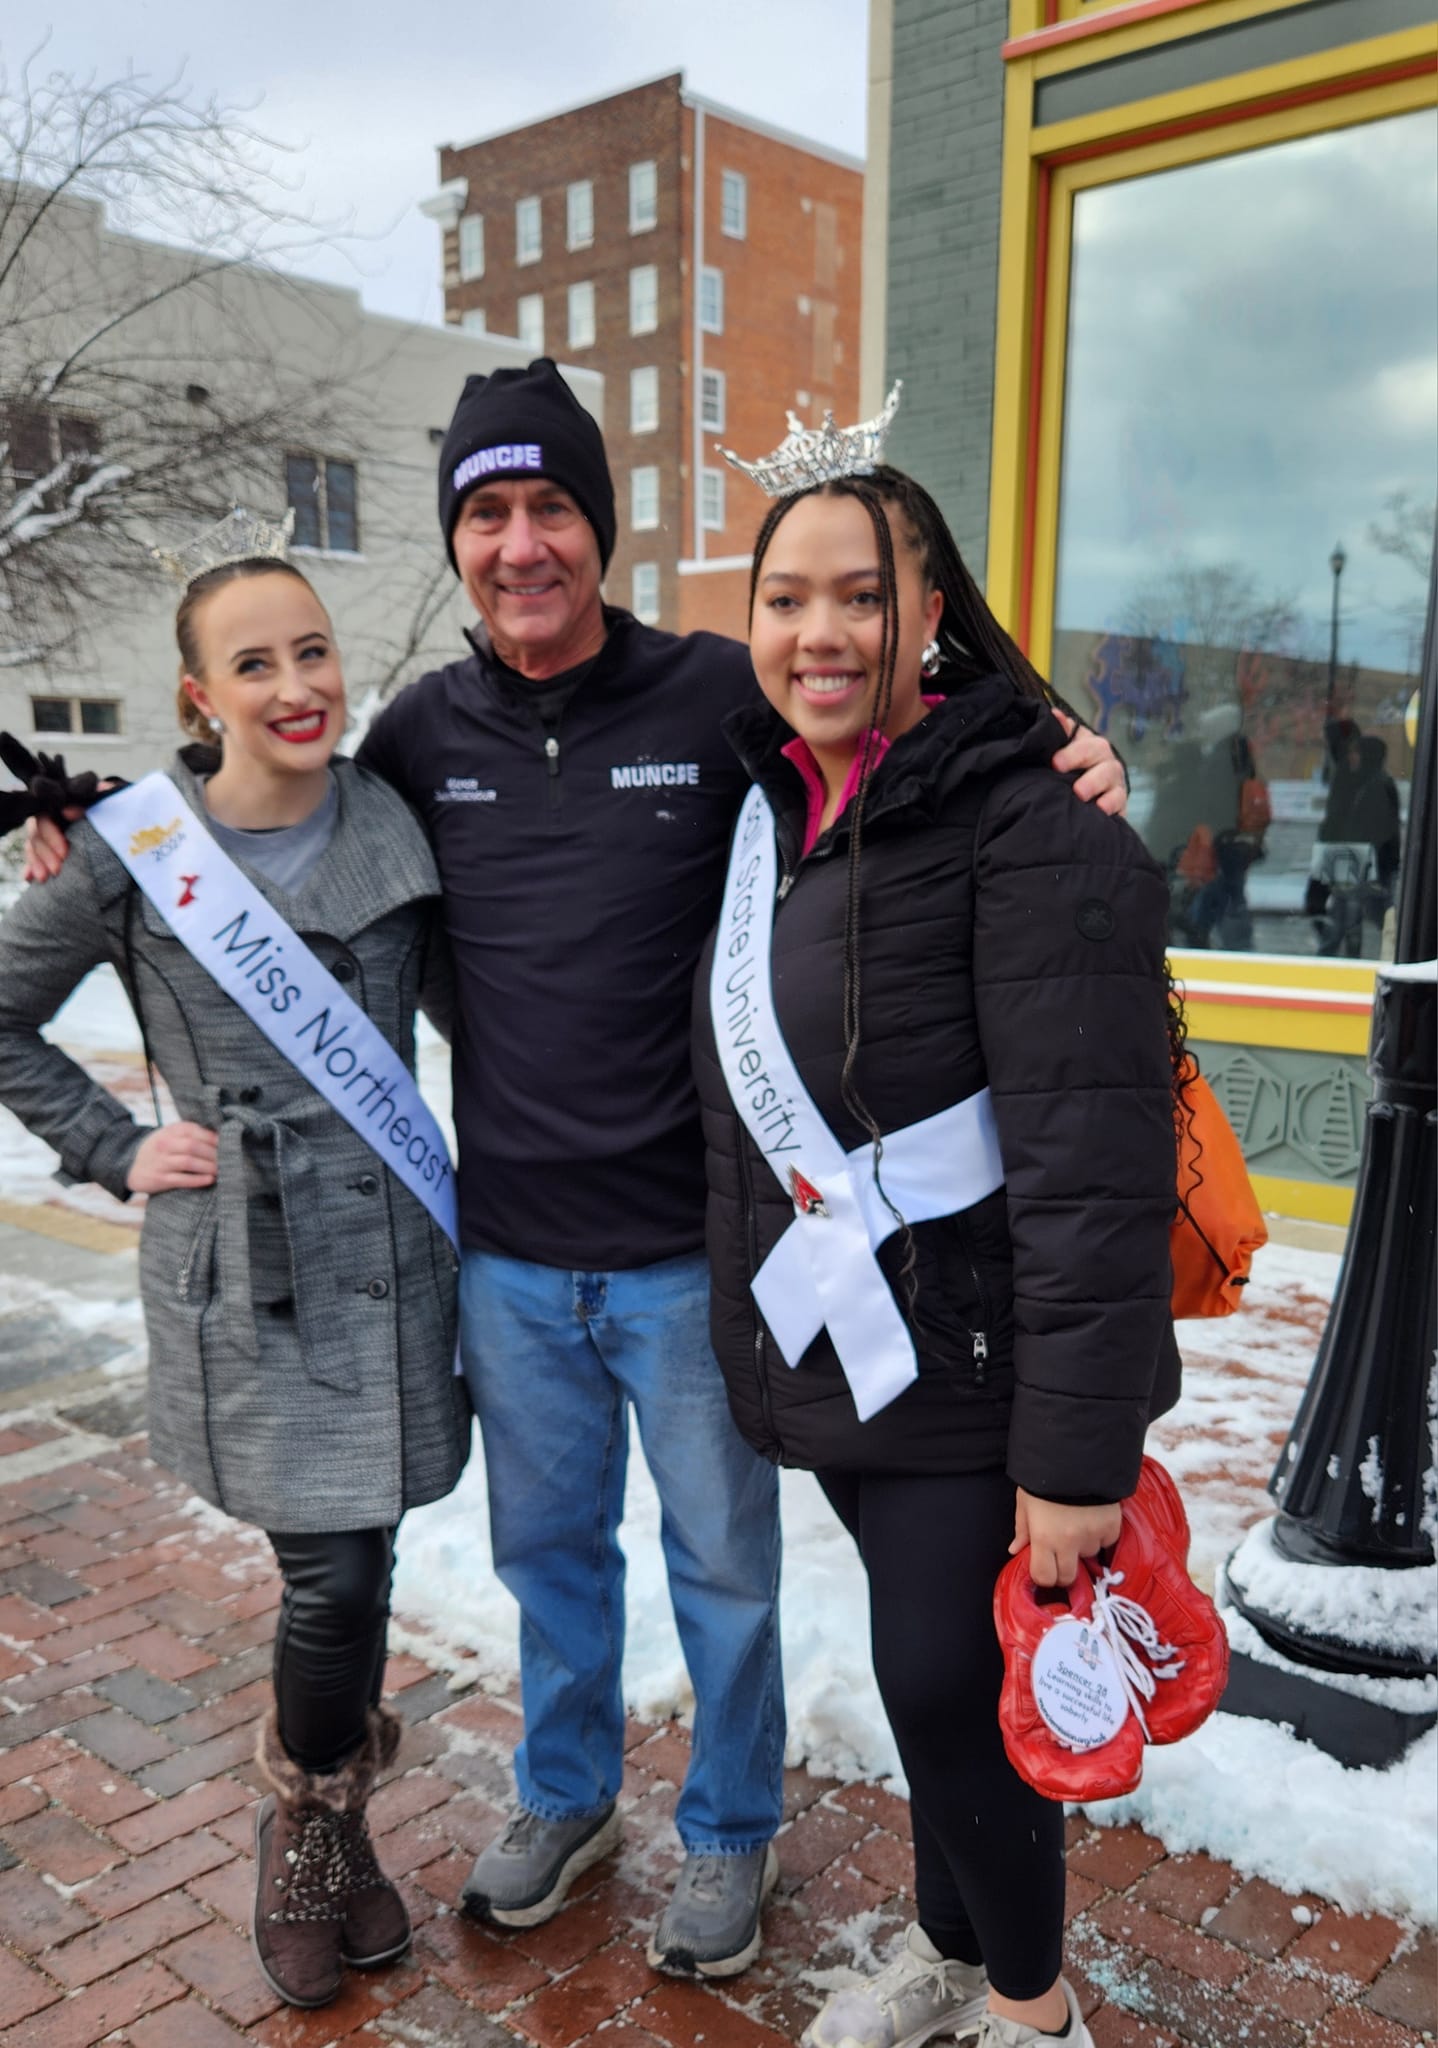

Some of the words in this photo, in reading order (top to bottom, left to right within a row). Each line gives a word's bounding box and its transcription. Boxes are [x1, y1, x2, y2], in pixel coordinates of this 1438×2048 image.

[453, 443, 542, 491] MUNCIE
[611, 763, 700, 790] MUNCIE
[728, 854, 761, 958] State
[212, 910, 302, 1014] Miss
[295, 1007, 451, 1193] Northeast
[725, 957, 802, 1155] University
[1039, 1676, 1053, 1691] live
[1062, 1692, 1101, 1718] successful
[1103, 1710, 1115, 1725] life
[1047, 1669, 1082, 1696] Learning
[1084, 1690, 1102, 1706] skills
[1104, 1702, 1112, 1712] to
[1060, 1703, 1088, 1724] soberly
